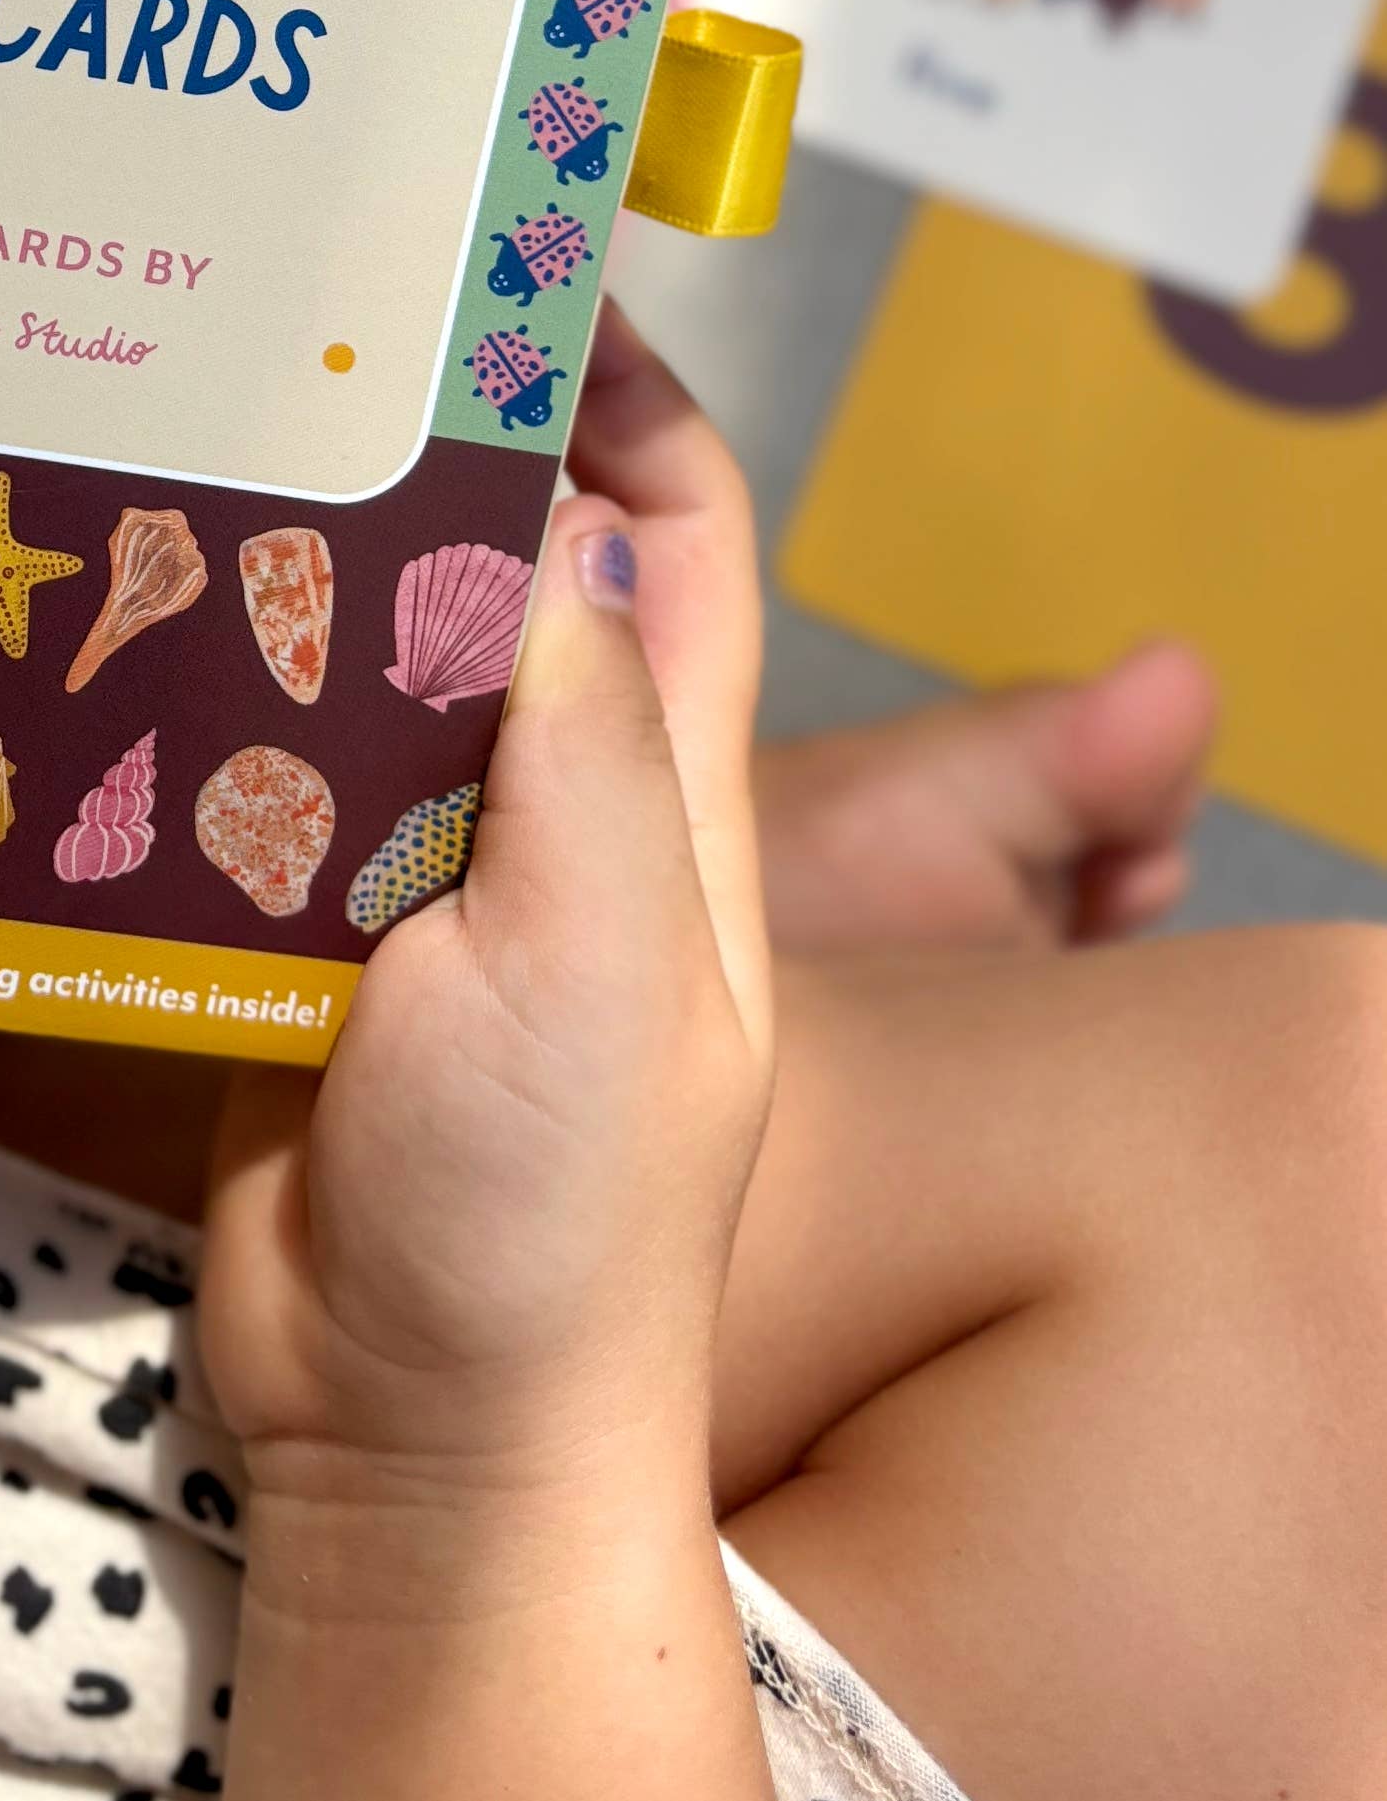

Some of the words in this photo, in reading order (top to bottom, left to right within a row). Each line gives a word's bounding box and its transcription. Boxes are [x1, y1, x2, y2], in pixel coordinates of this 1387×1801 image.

[142, 248, 213, 291] BY
[14, 310, 159, 366] Studio
[28, 972, 198, 1014] activities
[205, 984, 332, 1028] inside!
